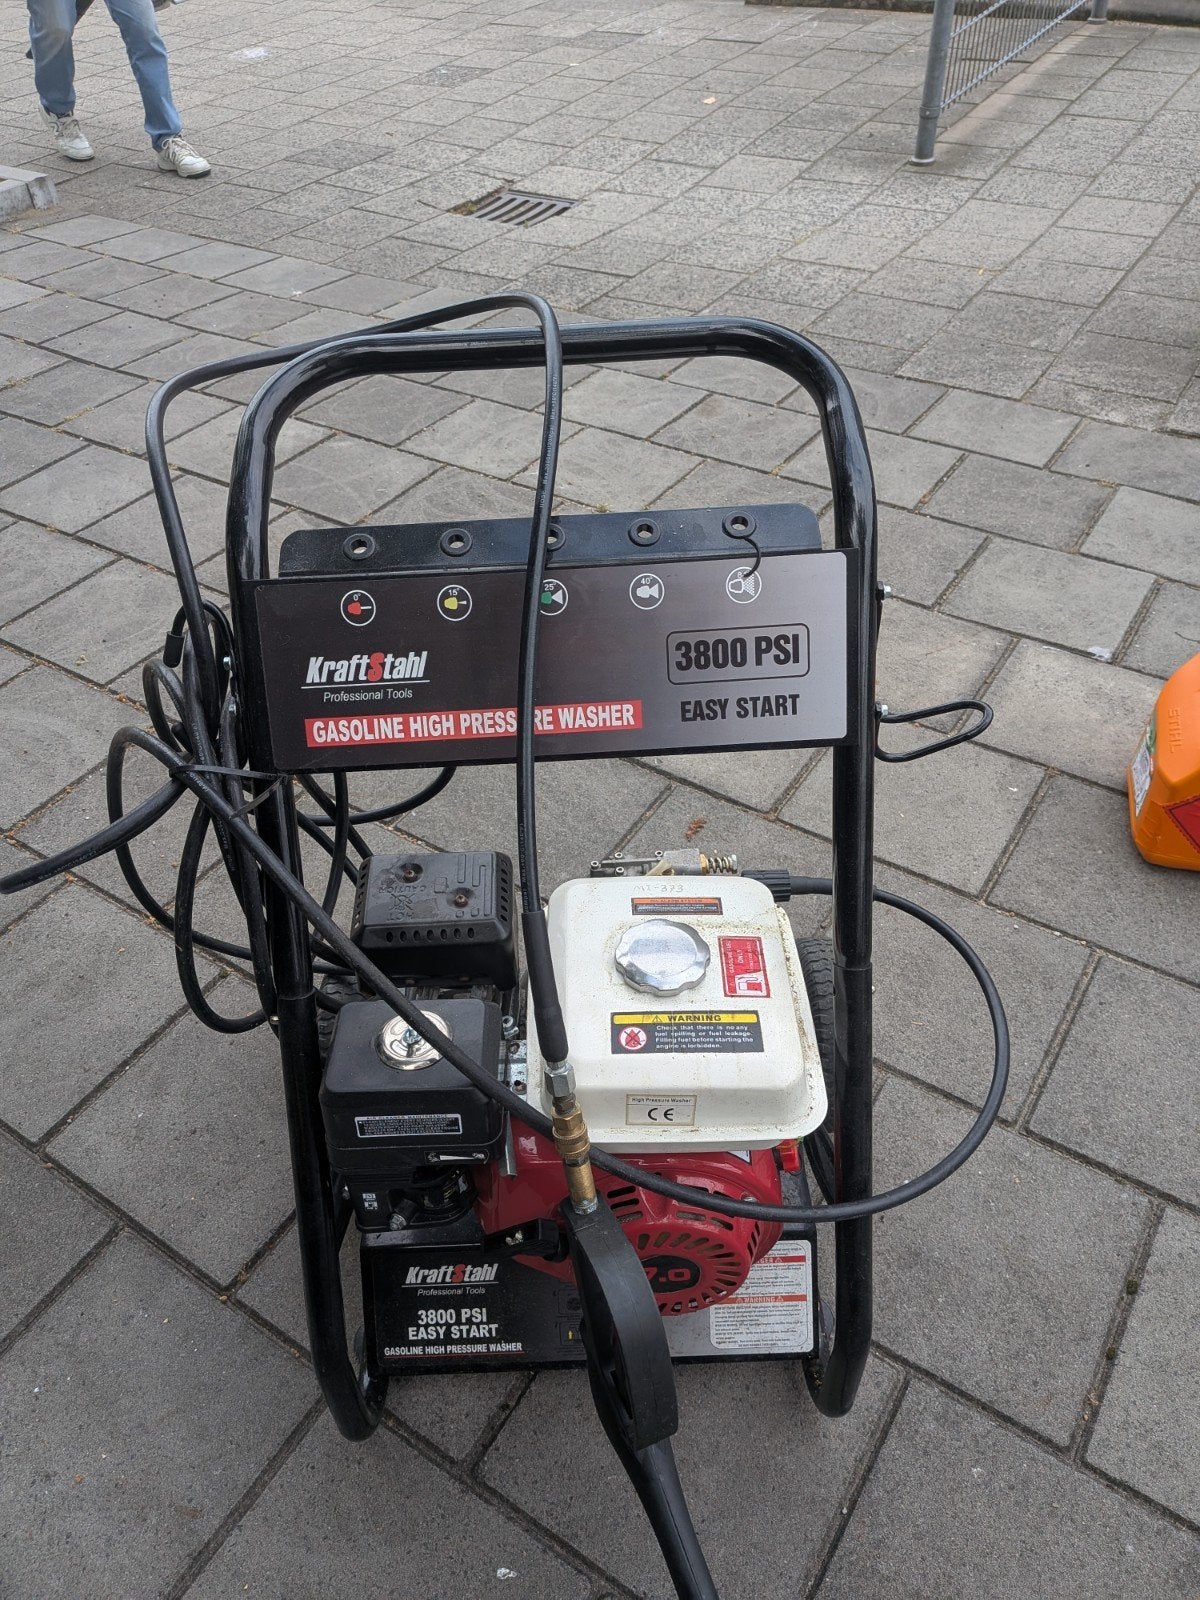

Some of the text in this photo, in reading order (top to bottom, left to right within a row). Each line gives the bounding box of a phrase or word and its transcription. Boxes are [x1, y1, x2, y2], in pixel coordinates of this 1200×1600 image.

[675, 634, 800, 671] 3800 PSI
[306, 651, 428, 683] KraftStahl
[323, 688, 413, 702] Professional Tools
[680, 694, 800, 722] EASY START
[313, 704, 635, 743] GASOLINE HIGH PRESSRE WASHER
[1168, 708, 1181, 754] STIHL
[667, 1014, 722, 1022] WARNING
[405, 1263, 499, 1284] KraftStahl
[417, 1286, 486, 1297] Professional Tools
[417, 1308, 487, 1324] 3800 PSI
[408, 1324, 499, 1340] EASY START
[384, 1342, 523, 1355] GASOLINE HIGH PRESSURE WASHER
